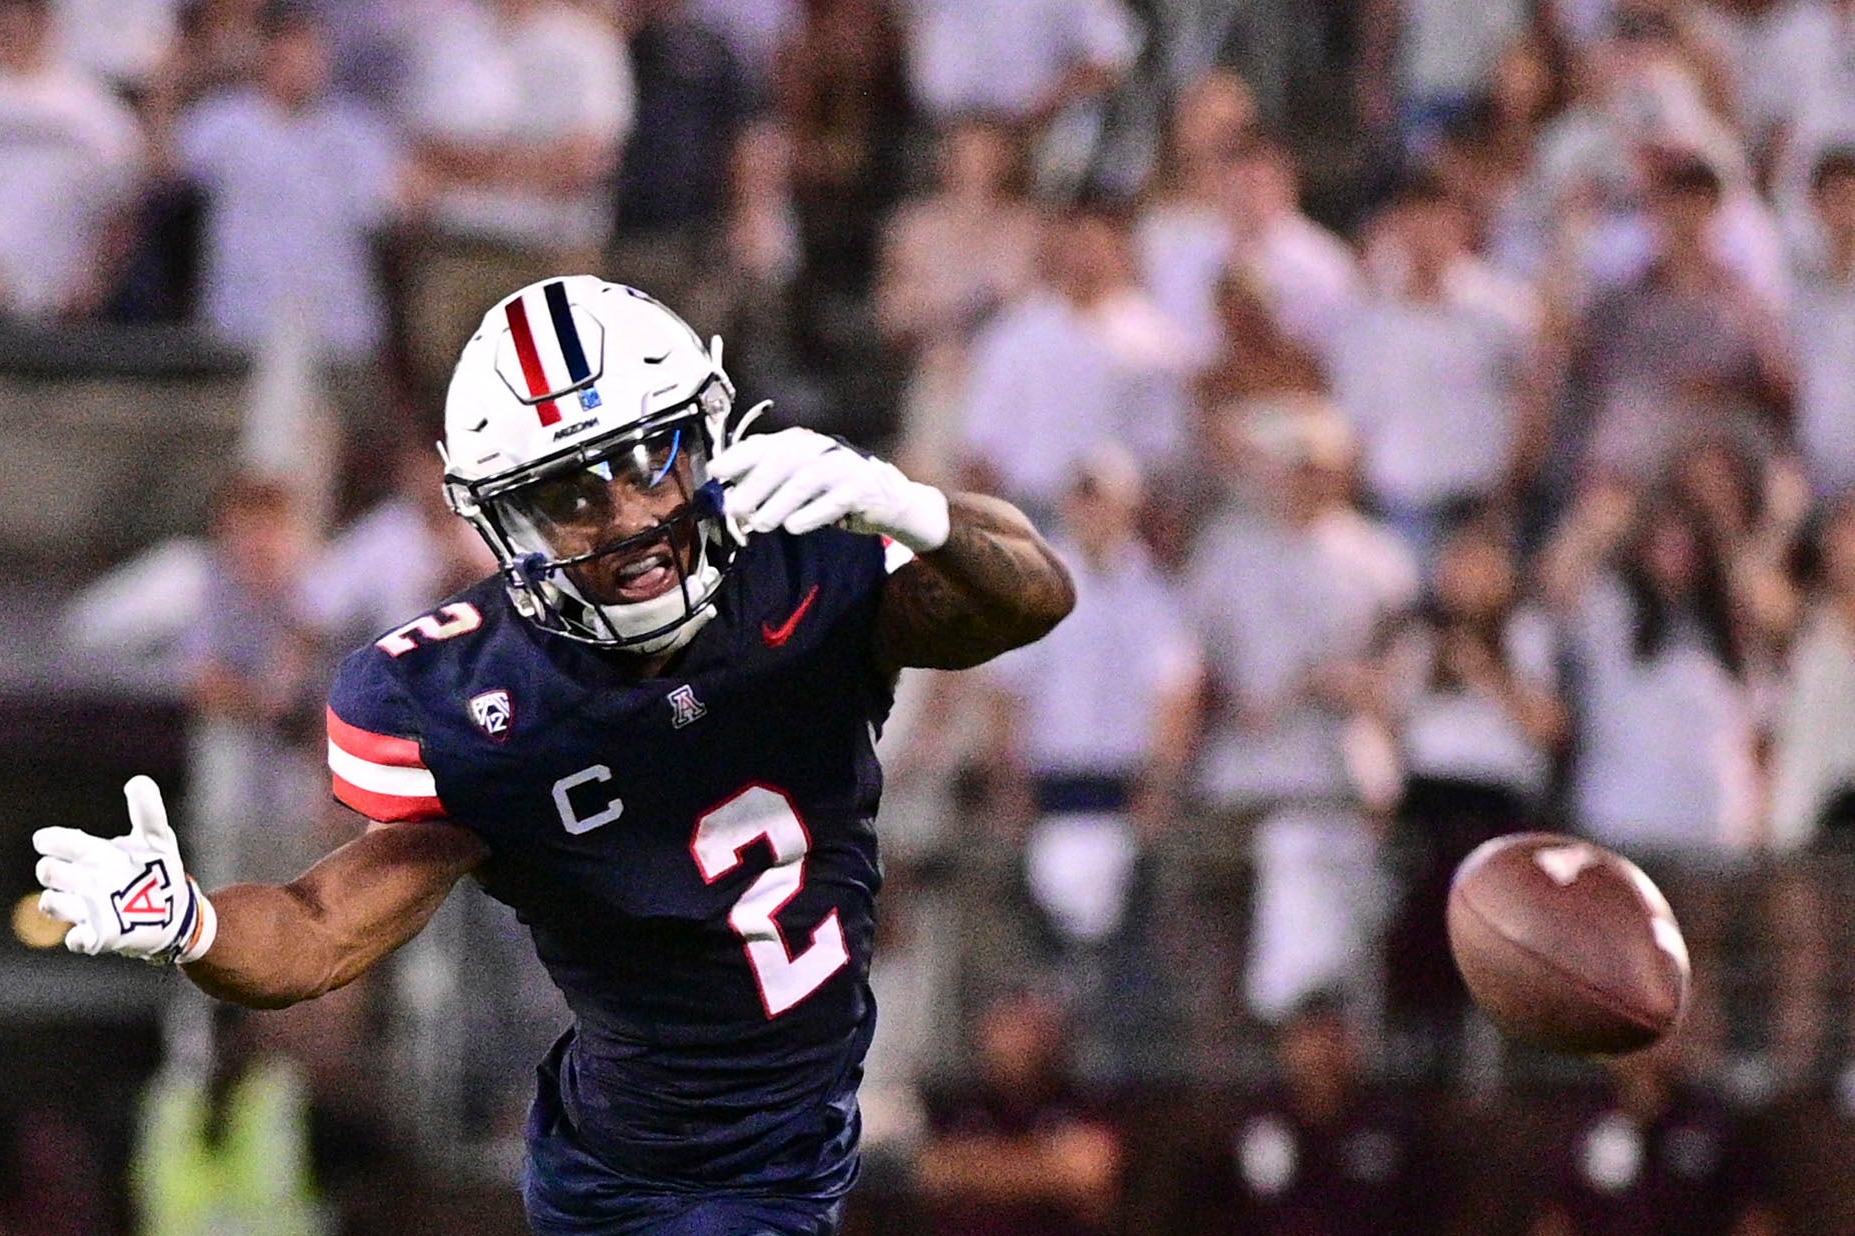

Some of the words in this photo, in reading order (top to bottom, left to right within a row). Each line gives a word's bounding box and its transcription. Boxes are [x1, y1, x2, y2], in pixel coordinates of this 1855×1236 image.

[375, 600, 484, 659] 2
[552, 764, 625, 836] C
[110, 857, 175, 936] A
[689, 779, 850, 1020] 2
